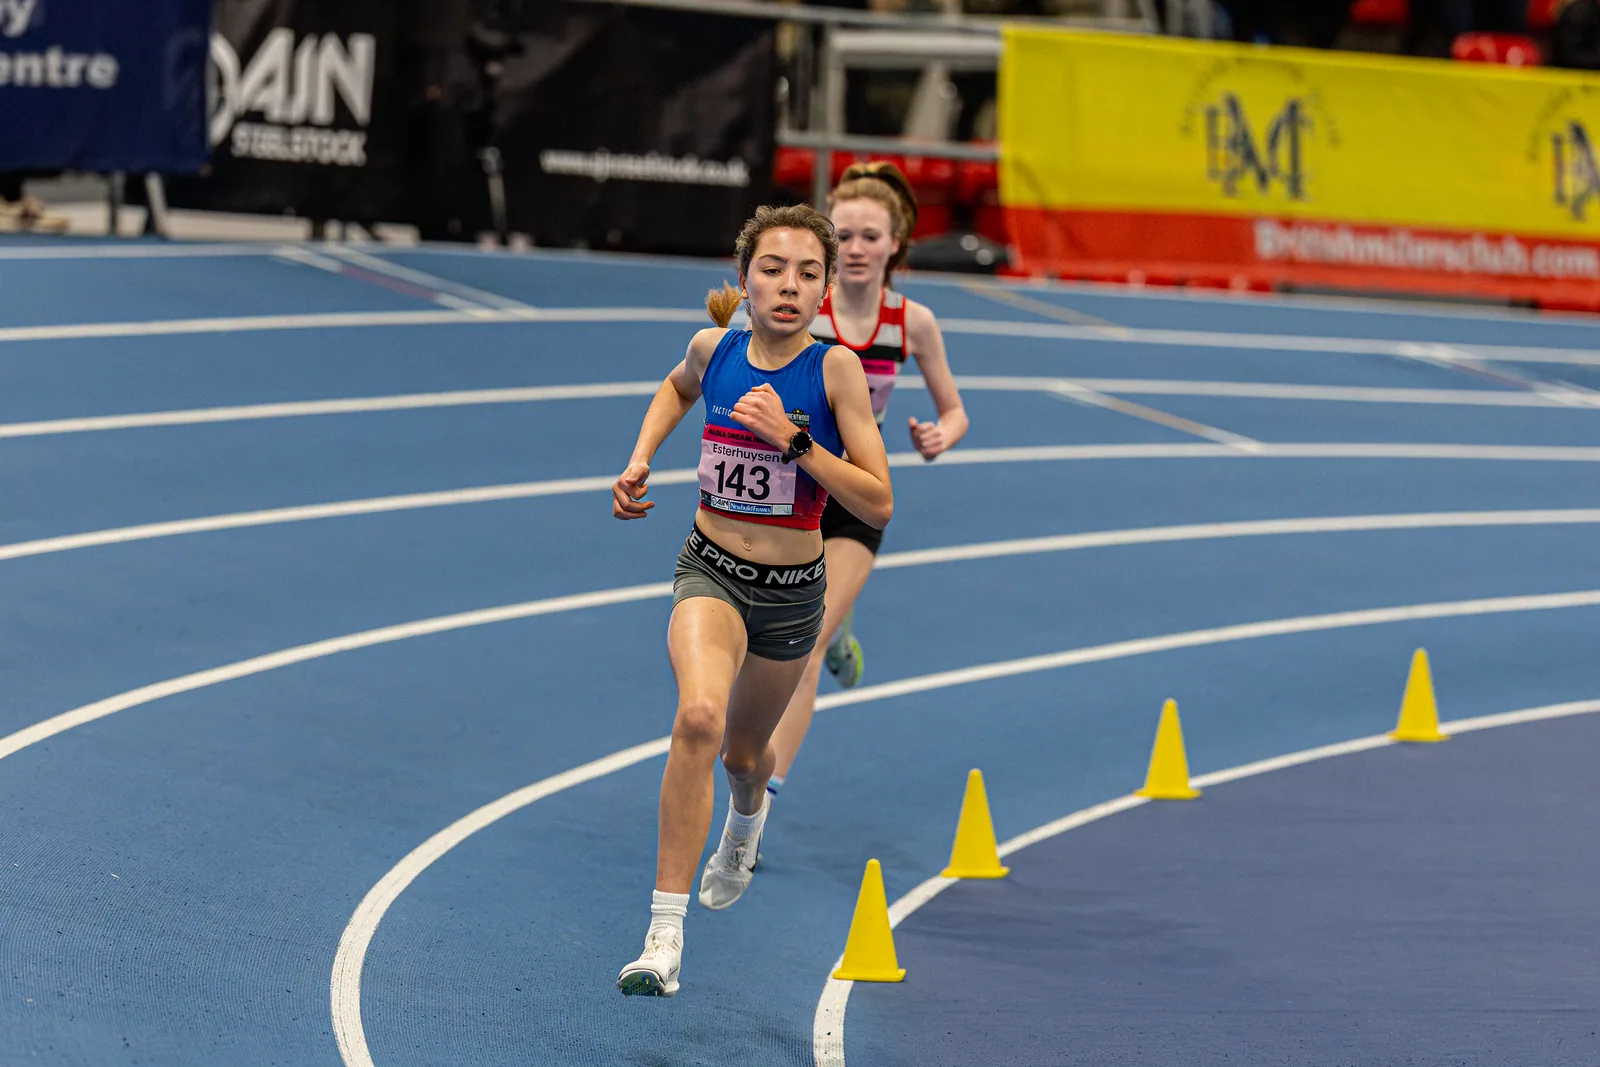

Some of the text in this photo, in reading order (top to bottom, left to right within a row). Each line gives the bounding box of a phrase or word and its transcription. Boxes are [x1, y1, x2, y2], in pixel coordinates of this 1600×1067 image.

[713, 444, 780, 463] Esterhuysen
[714, 461, 771, 500] 143
[700, 543, 759, 581] PRO
[764, 562, 825, 585] NIKE
